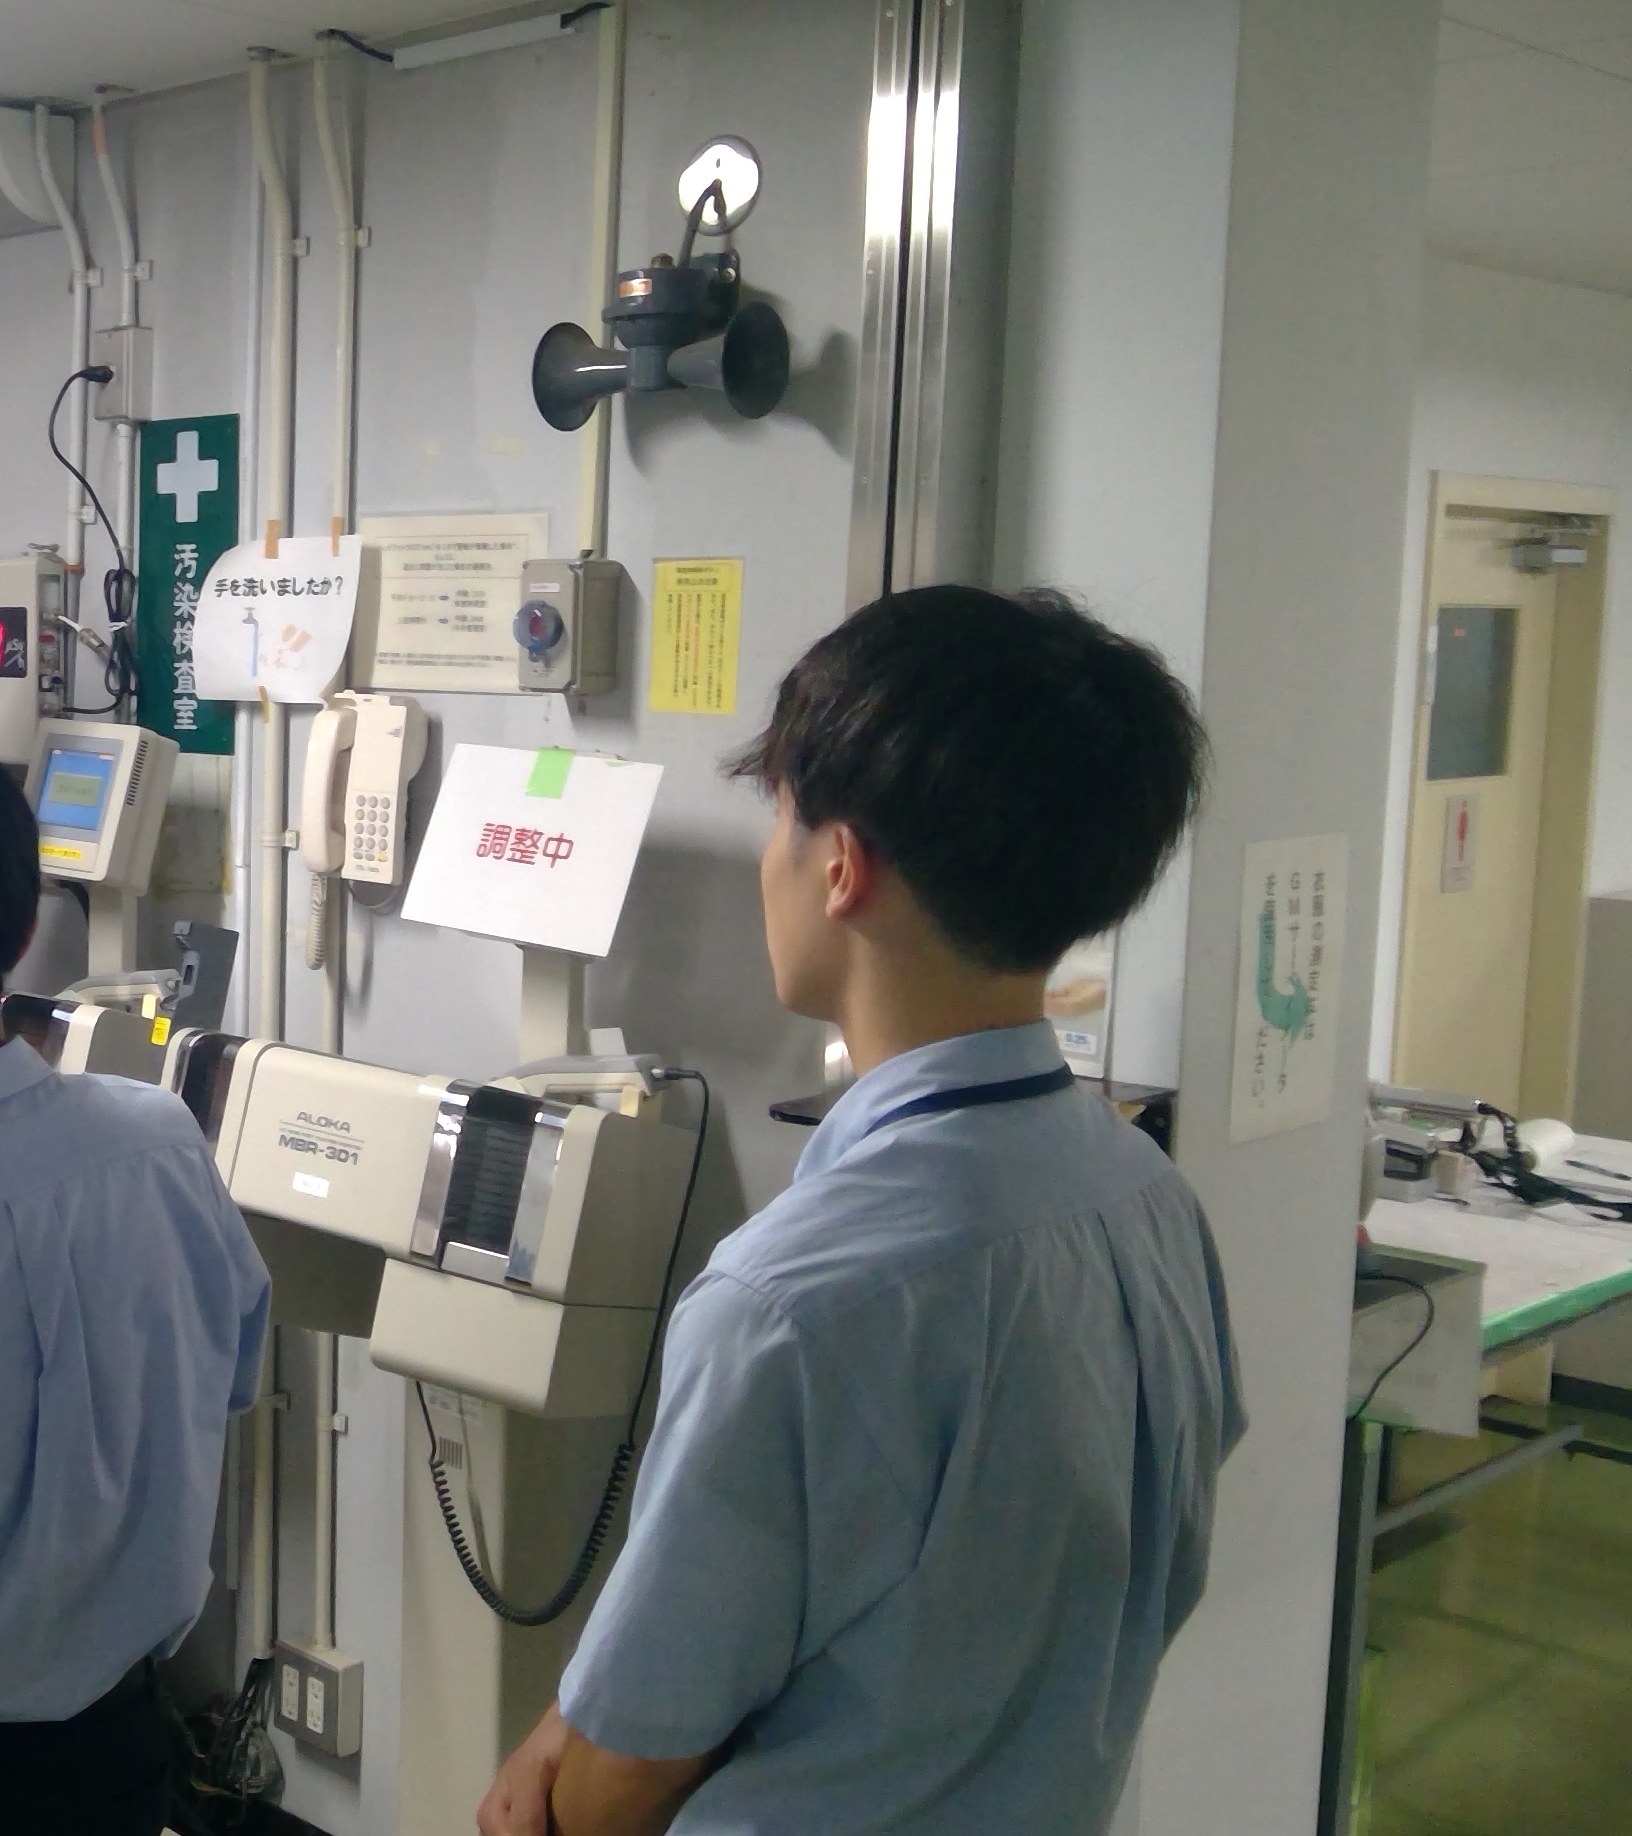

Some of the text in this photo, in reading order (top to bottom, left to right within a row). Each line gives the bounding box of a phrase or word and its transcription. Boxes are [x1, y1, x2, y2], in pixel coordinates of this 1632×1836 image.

[172, 543, 200, 730] 汚染検査室
[476, 822, 574, 869] 調整中
[296, 1111, 351, 1133] ALOKA
